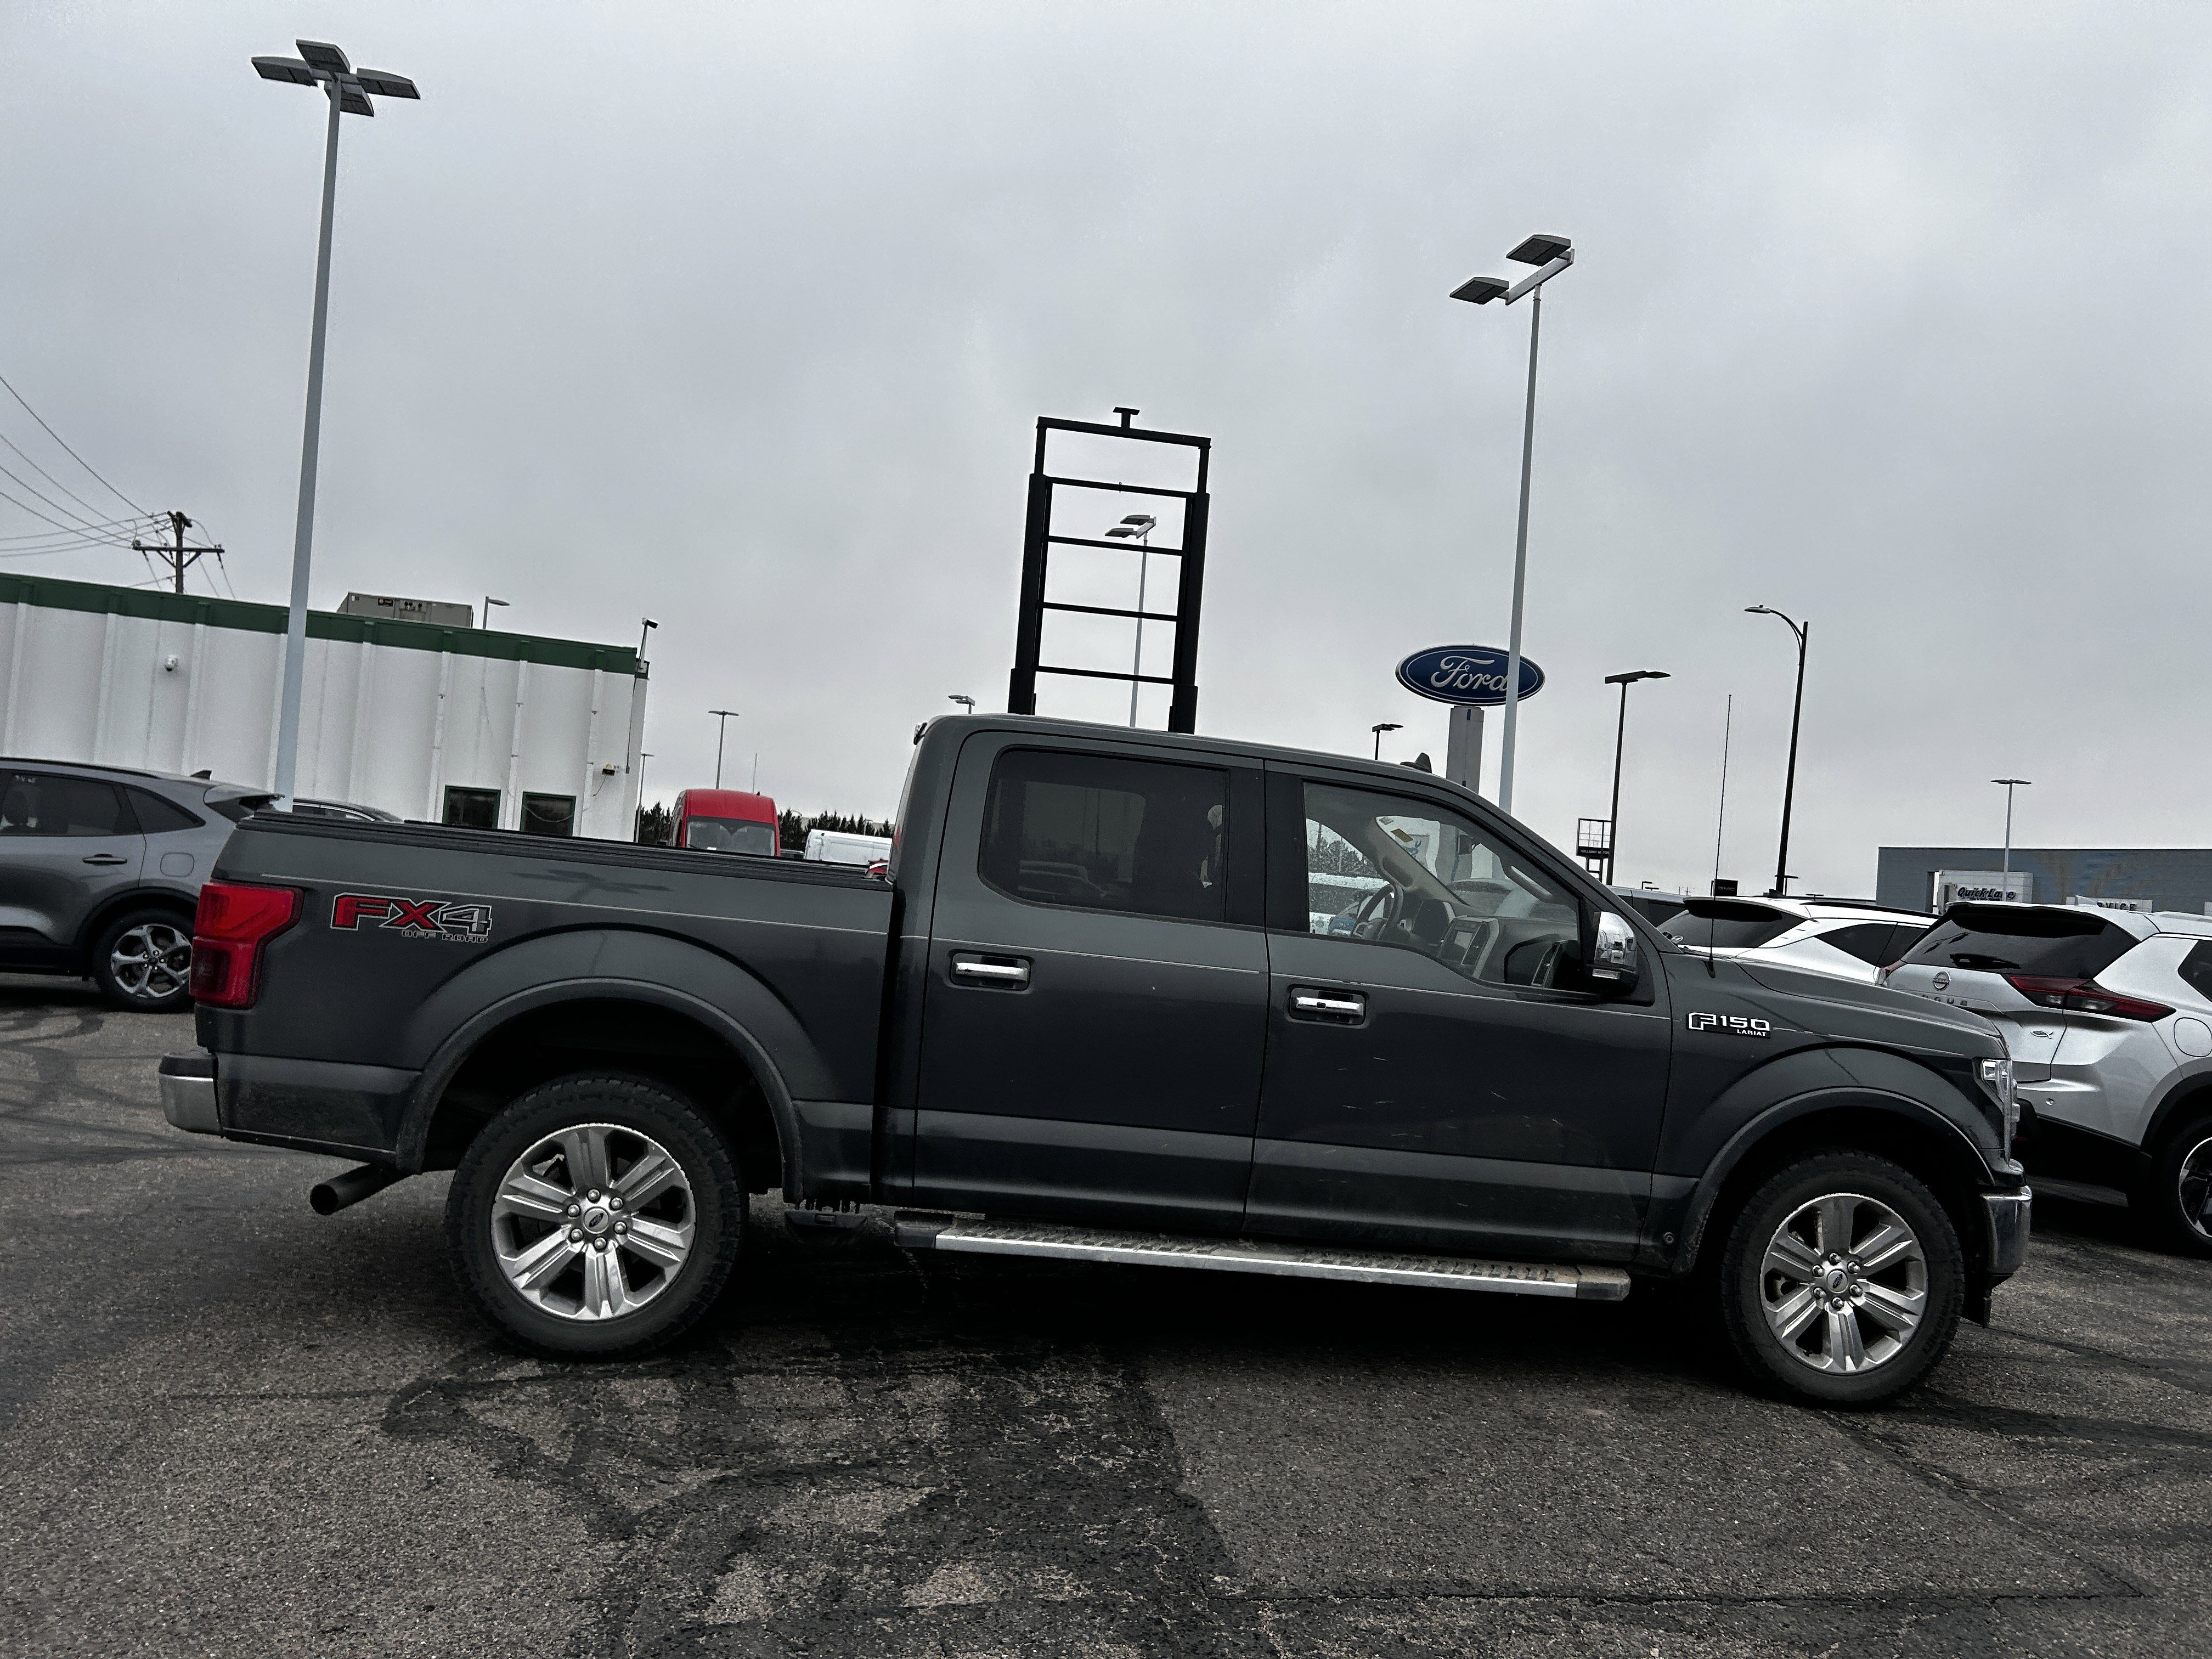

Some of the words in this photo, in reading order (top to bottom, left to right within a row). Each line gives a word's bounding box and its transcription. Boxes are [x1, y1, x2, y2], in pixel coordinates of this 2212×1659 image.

[1430, 656, 1508, 692] Ford
[1957, 887, 1988, 898] Quick
[330, 892, 492, 937] FX4
[402, 929, 436, 939] OFF
[442, 933, 488, 944] ROAD
[1737, 1029, 1768, 1037] LARIAT
